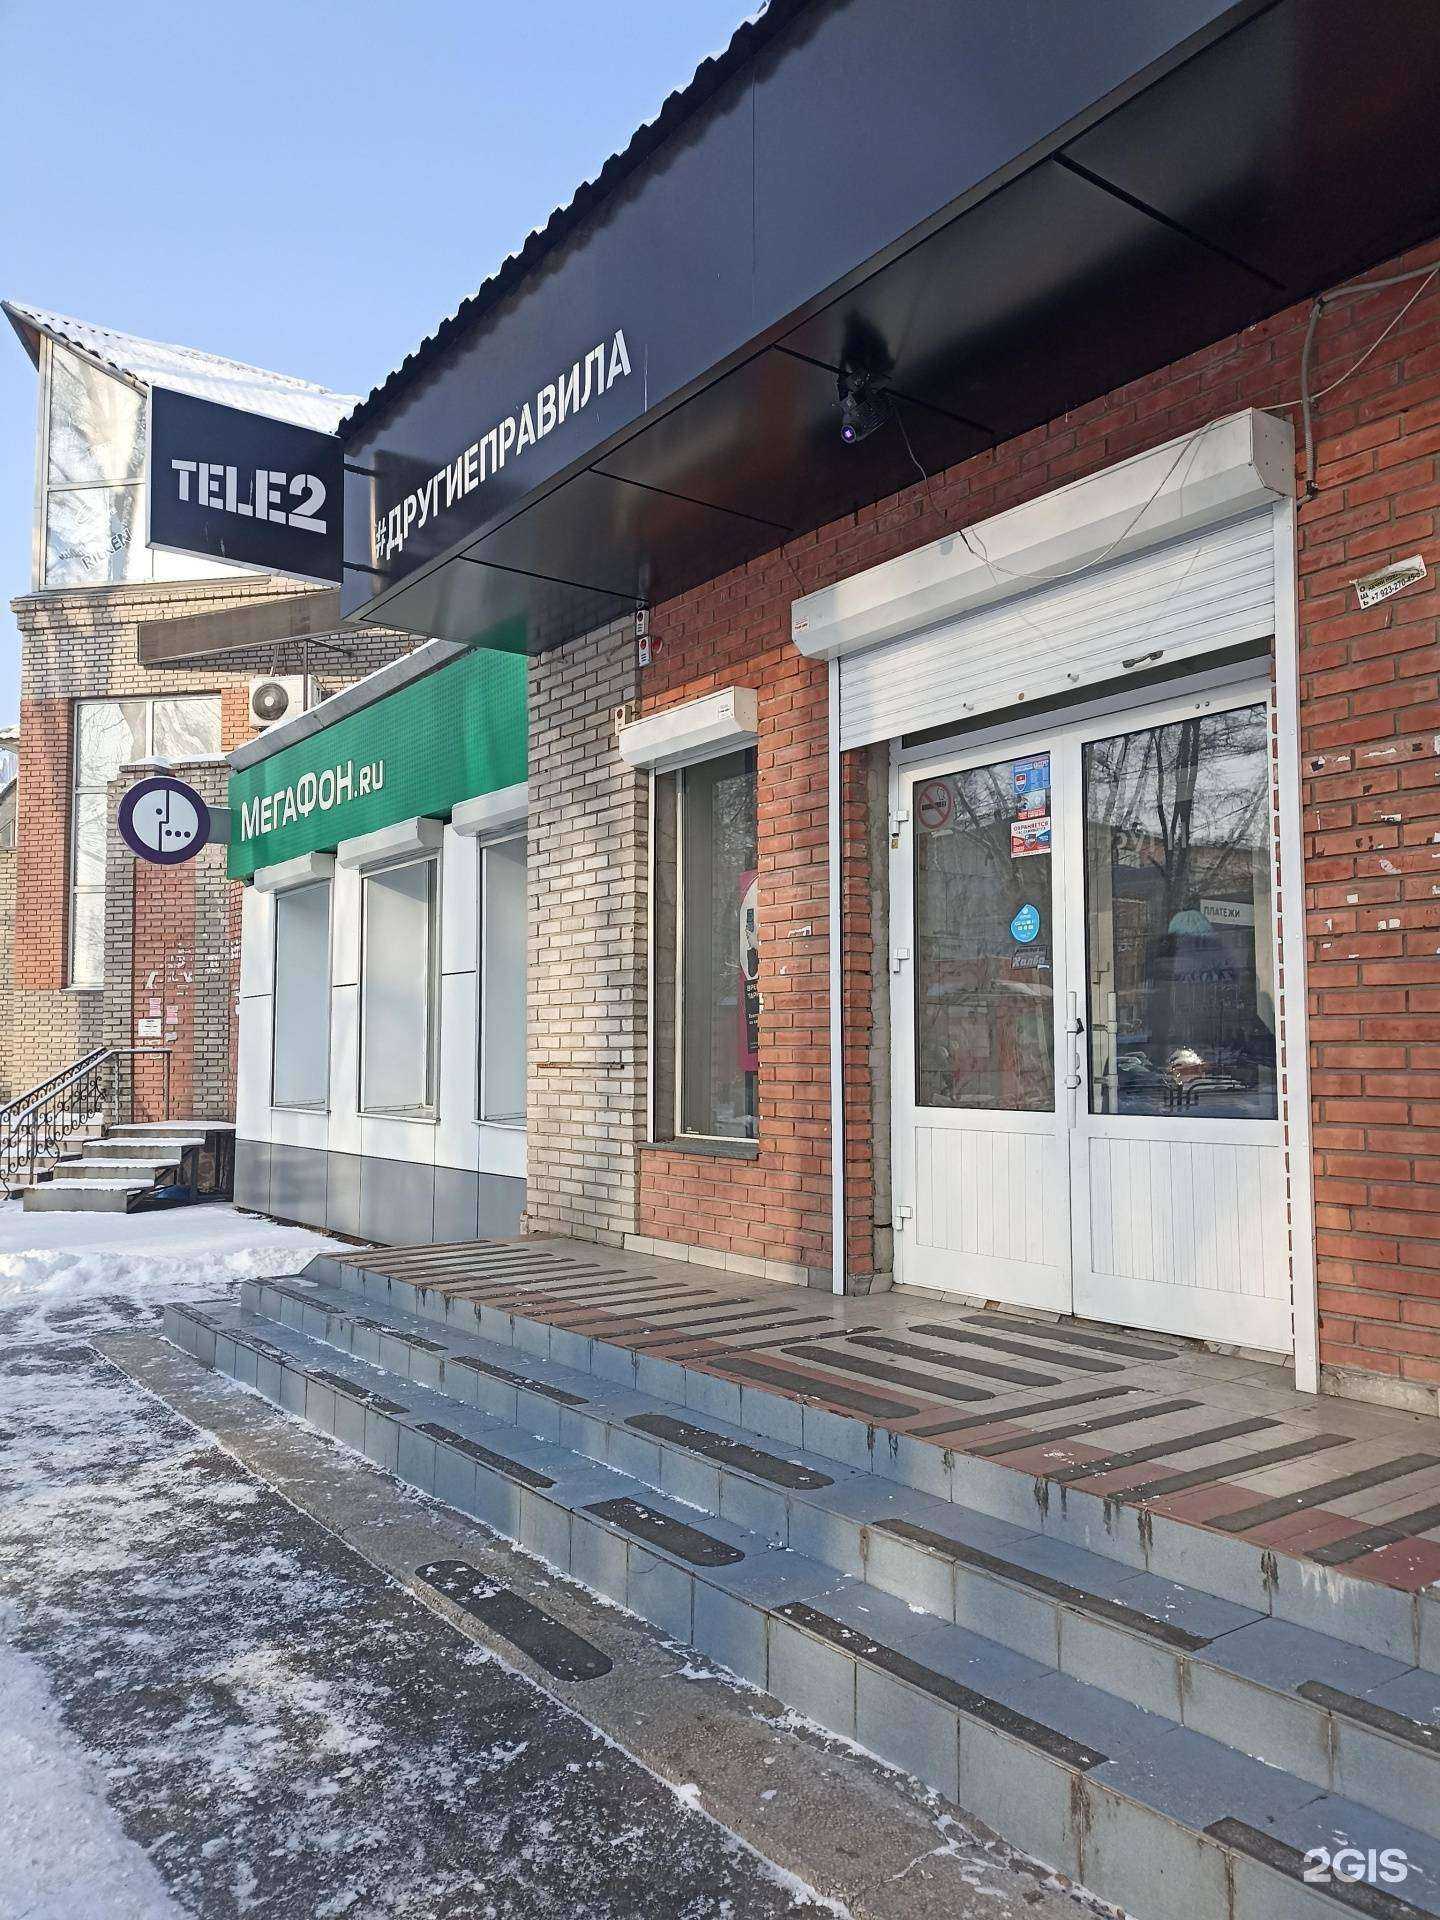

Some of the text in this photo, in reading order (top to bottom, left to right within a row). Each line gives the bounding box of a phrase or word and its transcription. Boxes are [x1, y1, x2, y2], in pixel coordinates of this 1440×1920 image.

[376, 329, 632, 560] #ДРУГИЕПРАВИЛА
[171, 459, 327, 534] TELE2
[1204, 906, 1240, 918] ПЛАТЕЖИ
